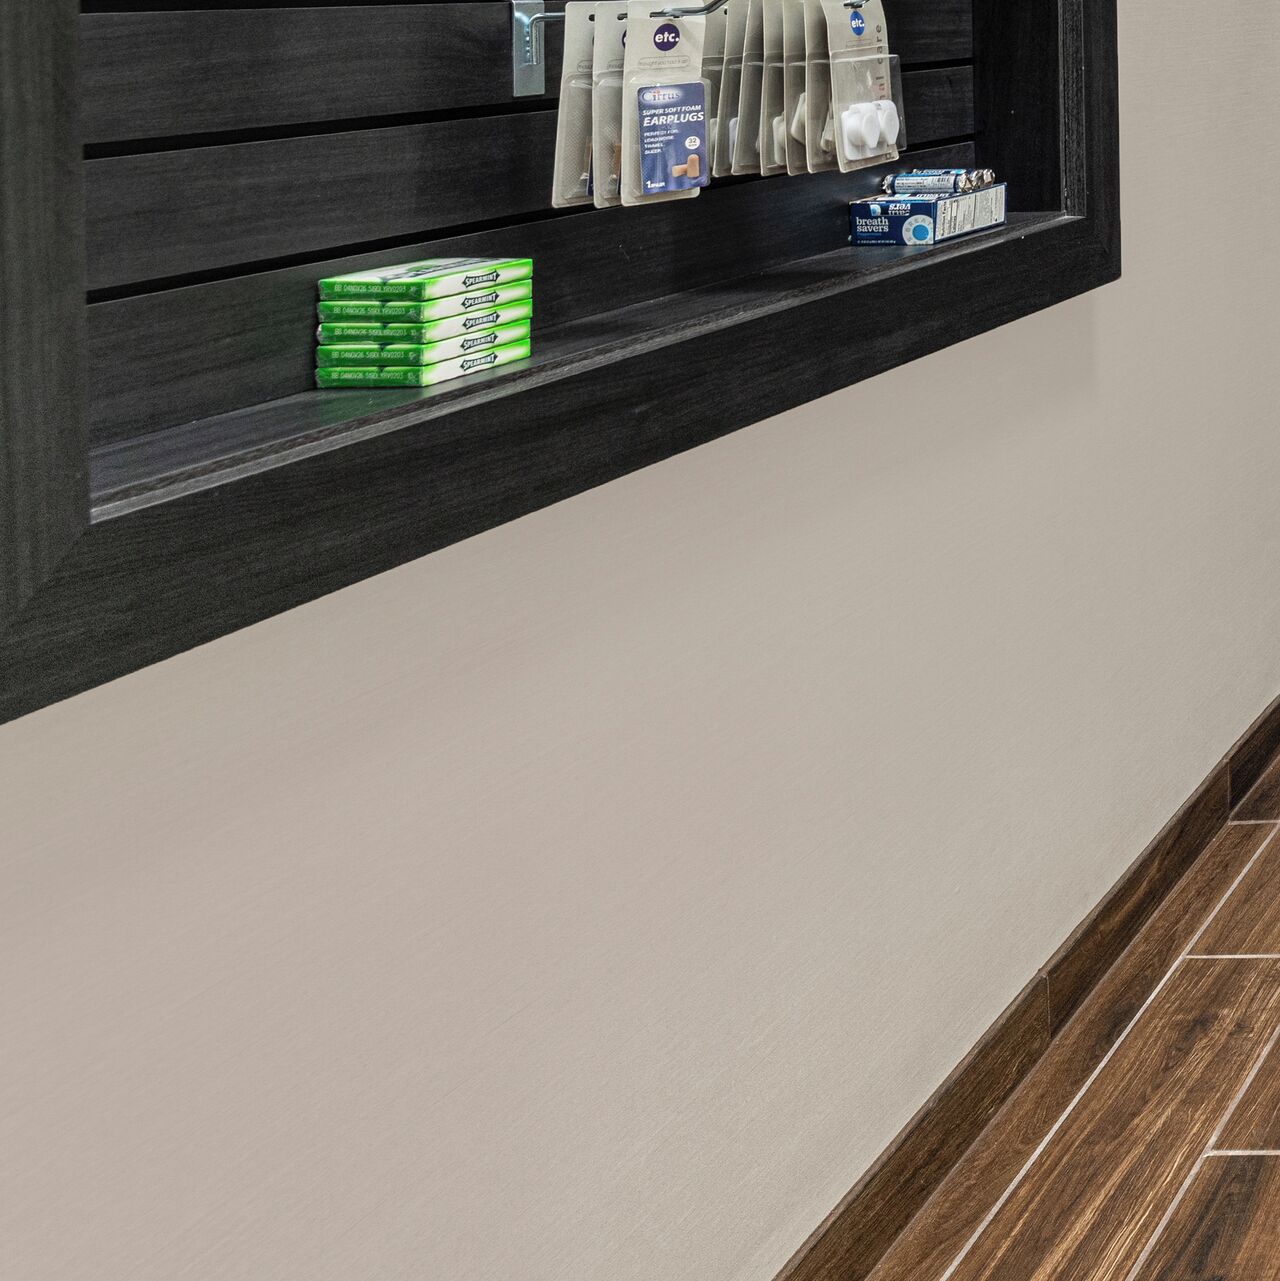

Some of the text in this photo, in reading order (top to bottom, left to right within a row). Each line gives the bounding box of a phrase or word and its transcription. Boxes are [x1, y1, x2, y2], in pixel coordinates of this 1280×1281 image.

[654, 30, 680, 43] etc.
[642, 89, 681, 102] Cirrus
[643, 104, 702, 116] SUPER SOFT FOAM
[643, 111, 704, 127] EARPLUGS
[856, 216, 889, 226] breath
[856, 225, 889, 233] savers
[466, 272, 497, 287] SPEARMINT
[464, 293, 496, 307] SPEARMINT
[465, 313, 497, 328] SPEARMINT
[463, 334, 496, 349] SPEARMINT
[463, 354, 496, 369] SPEARMINT
